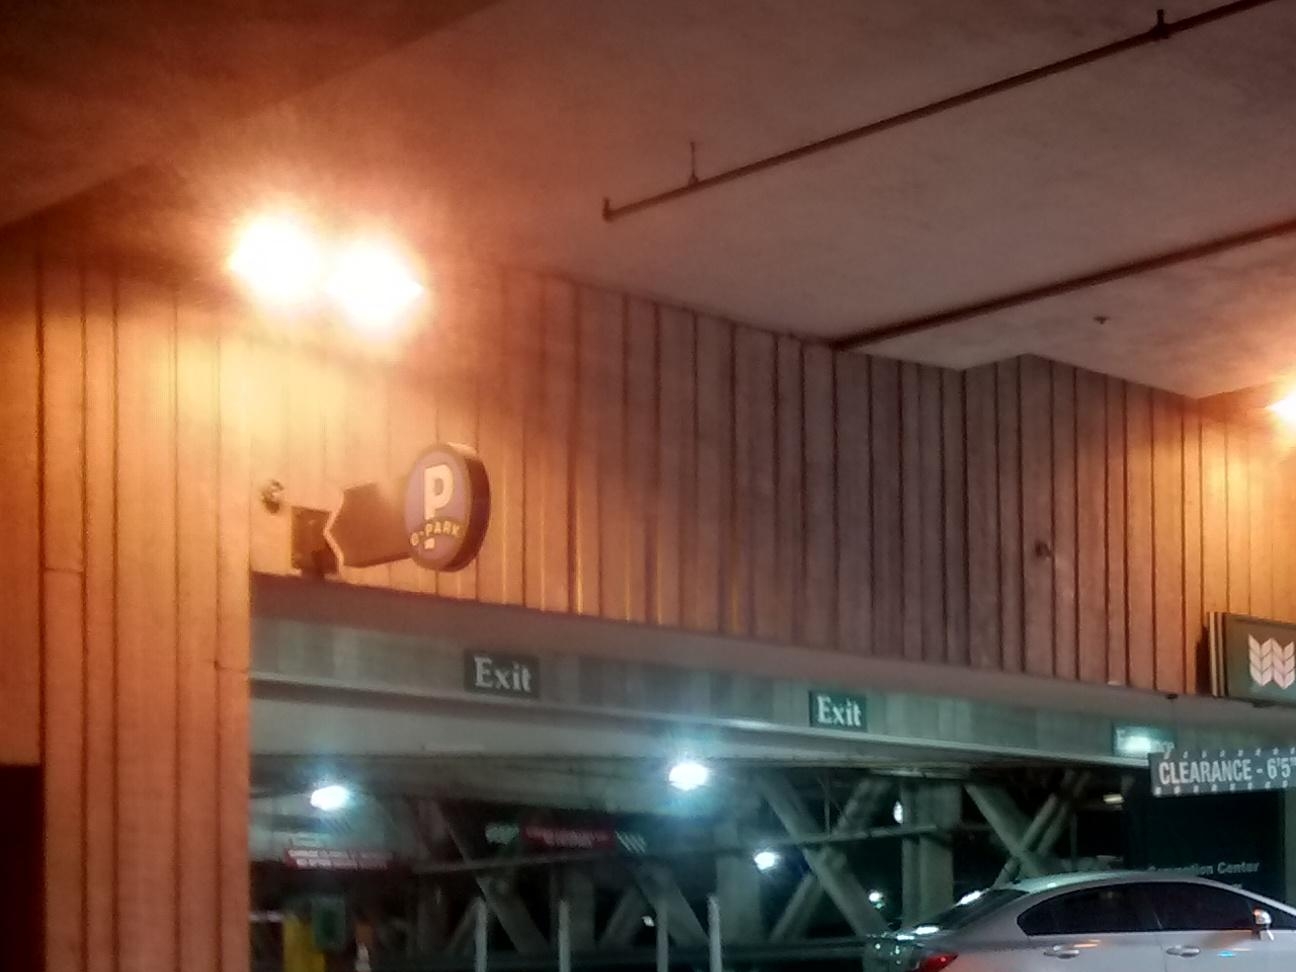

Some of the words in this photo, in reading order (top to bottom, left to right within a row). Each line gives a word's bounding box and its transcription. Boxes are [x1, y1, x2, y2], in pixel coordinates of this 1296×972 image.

[423, 463, 455, 549] P
[474, 656, 533, 691] Exit
[816, 695, 863, 727] Exit
[1158, 757, 1254, 785] CLEARANCE
[1217, 861, 1261, 875] Center
